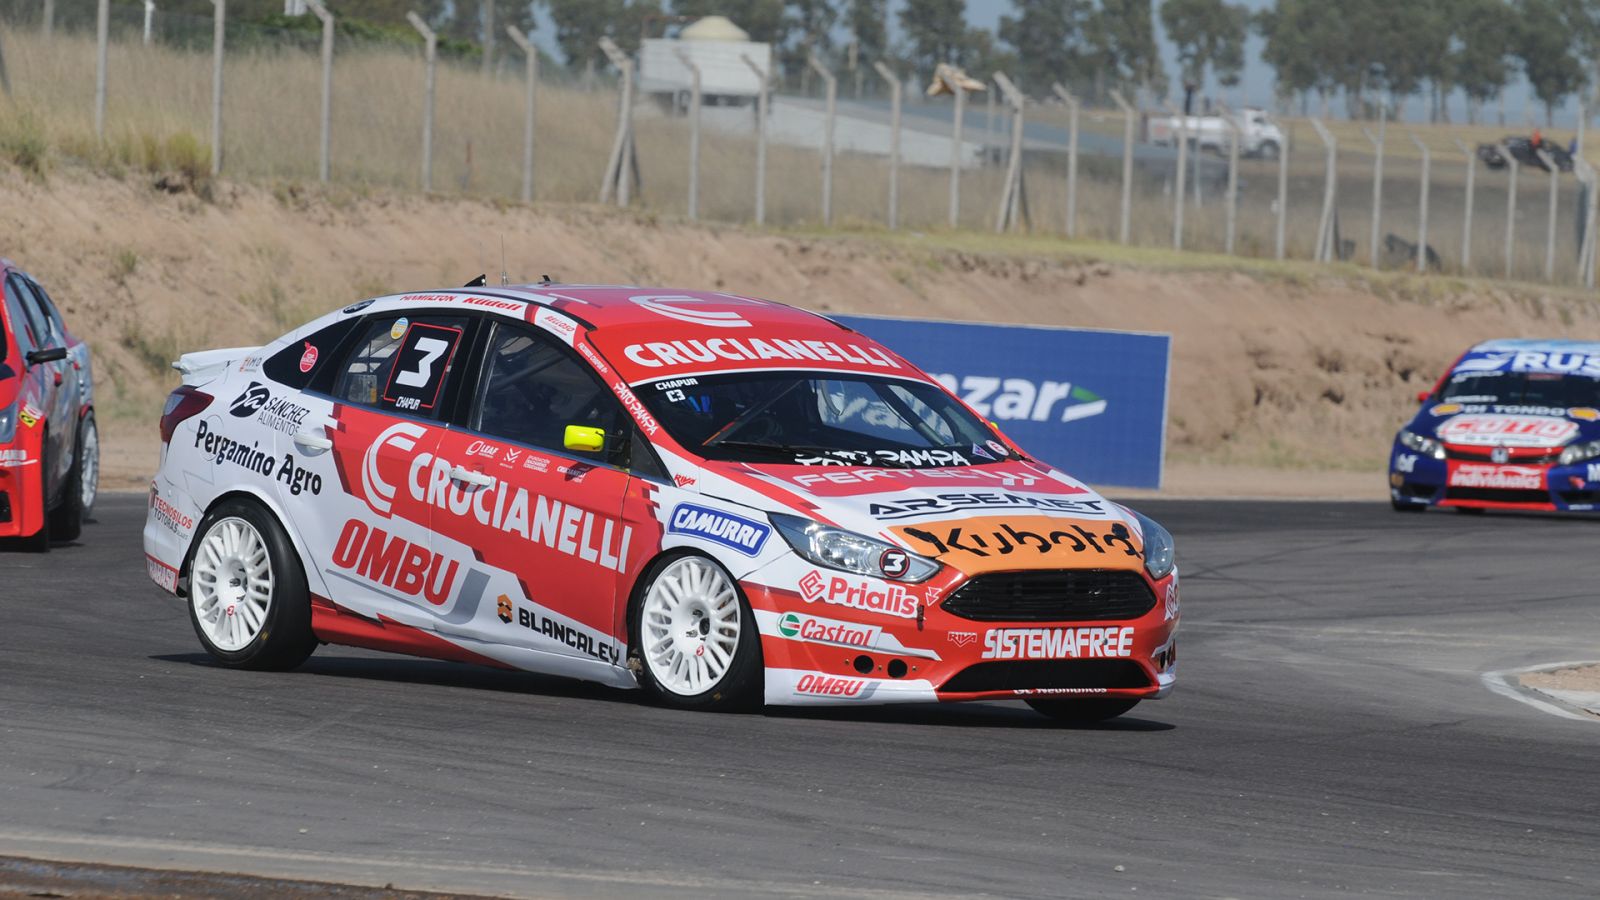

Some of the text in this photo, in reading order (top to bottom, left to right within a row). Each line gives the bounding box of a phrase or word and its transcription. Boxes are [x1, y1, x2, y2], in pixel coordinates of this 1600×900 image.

[396, 337, 448, 388] 3
[624, 338, 902, 368] CRUCIANELLI
[655, 378, 698, 391] CHAPUR
[665, 389, 686, 402] C3
[264, 396, 311, 425] SÁNCHEZ
[395, 396, 421, 410] CHAPUR
[613, 382, 659, 435] PATO PAMPA
[194, 419, 322, 495] Pergamino Agro
[480, 444, 499, 455] LEAF
[154, 496, 193, 530] TECNOSILOS
[408, 452, 632, 574] CRUCIANELLI
[870, 493, 1104, 516] ARSEMET
[153, 507, 179, 533] TOTORAS
[674, 508, 763, 549] CAMURRI
[332, 519, 459, 606] OMBU
[884, 554, 905, 571] 3
[829, 577, 918, 615] Prialis
[518, 606, 620, 665] BLANCALEY
[801, 619, 873, 646] Castrol
[948, 631, 977, 647] RIVA
[981, 627, 1135, 659] SISTEMAFREE
[797, 674, 864, 696] OMBU
